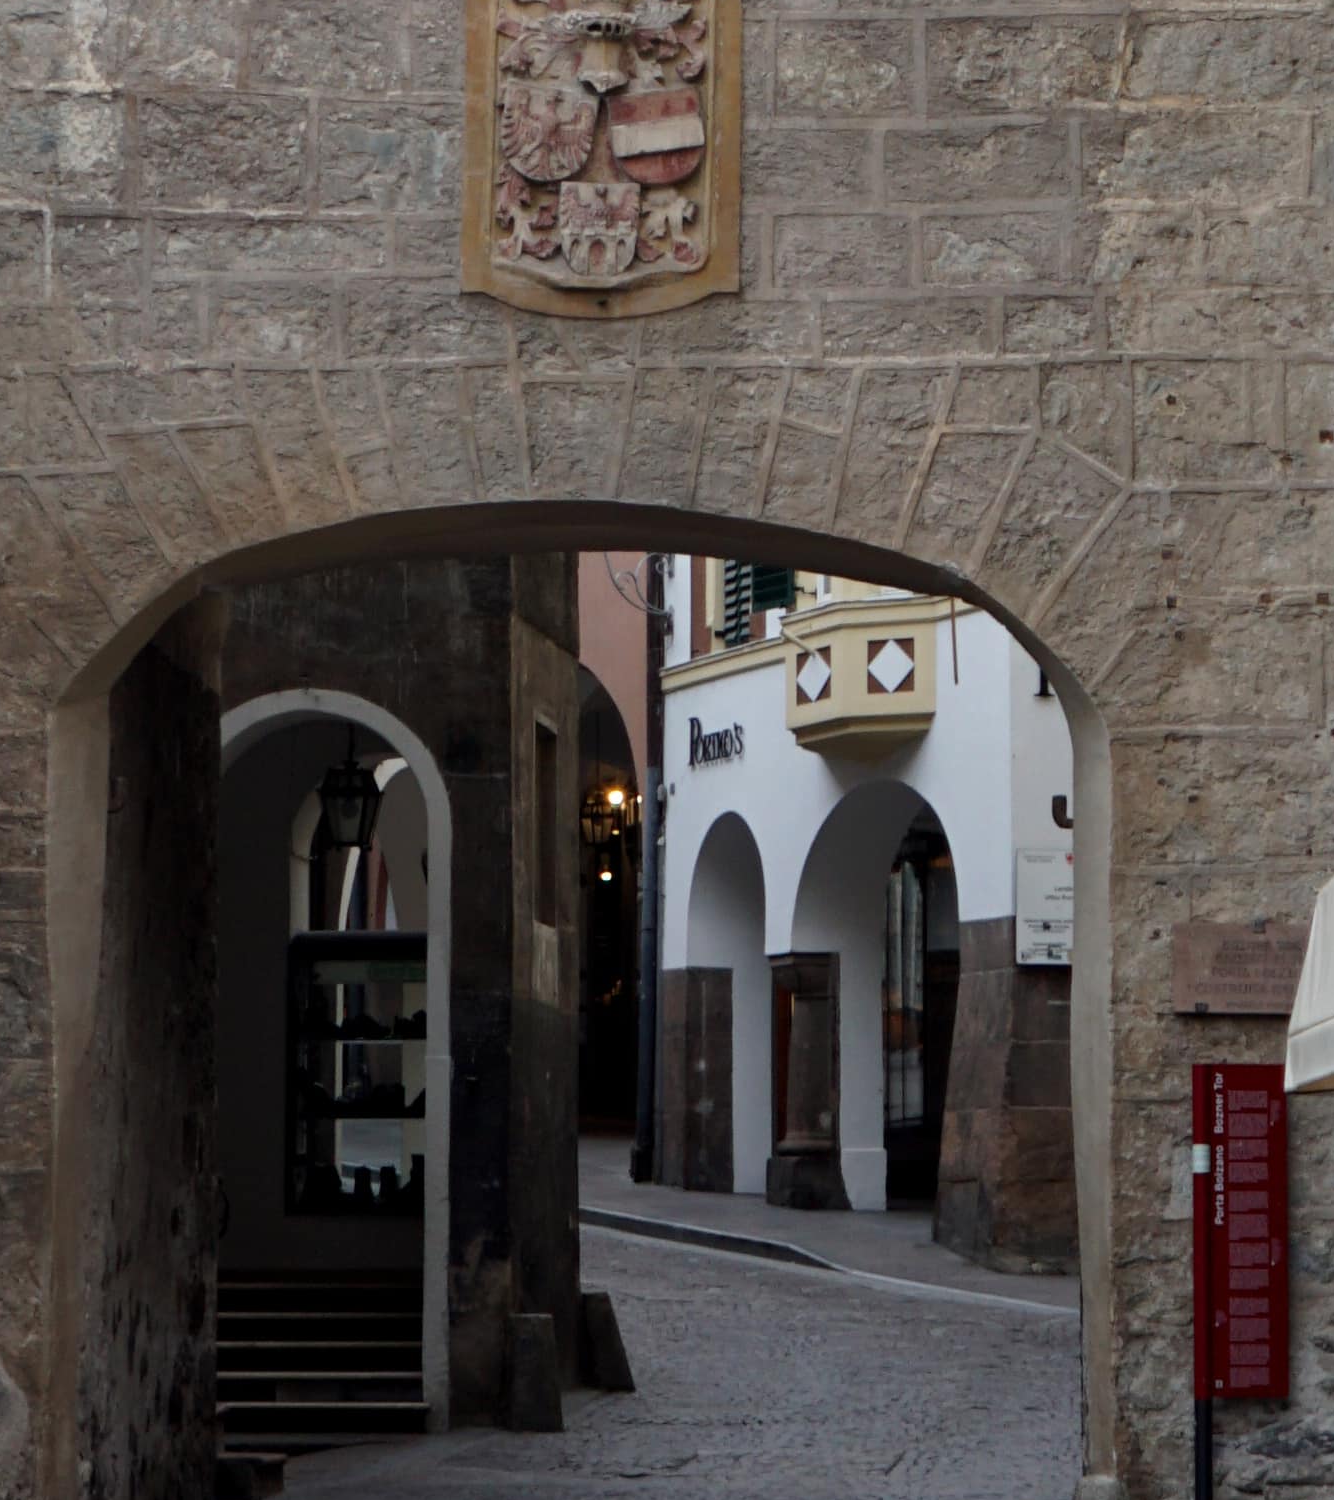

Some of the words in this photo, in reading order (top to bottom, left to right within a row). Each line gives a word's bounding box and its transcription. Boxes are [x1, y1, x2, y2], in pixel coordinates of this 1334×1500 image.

[1214, 1073, 1223, 1089] Tor
[1214, 1094, 1224, 1134] Bozner
[1214, 1144, 1224, 1192] Bolzano
[1215, 1193, 1224, 1225] Porta
